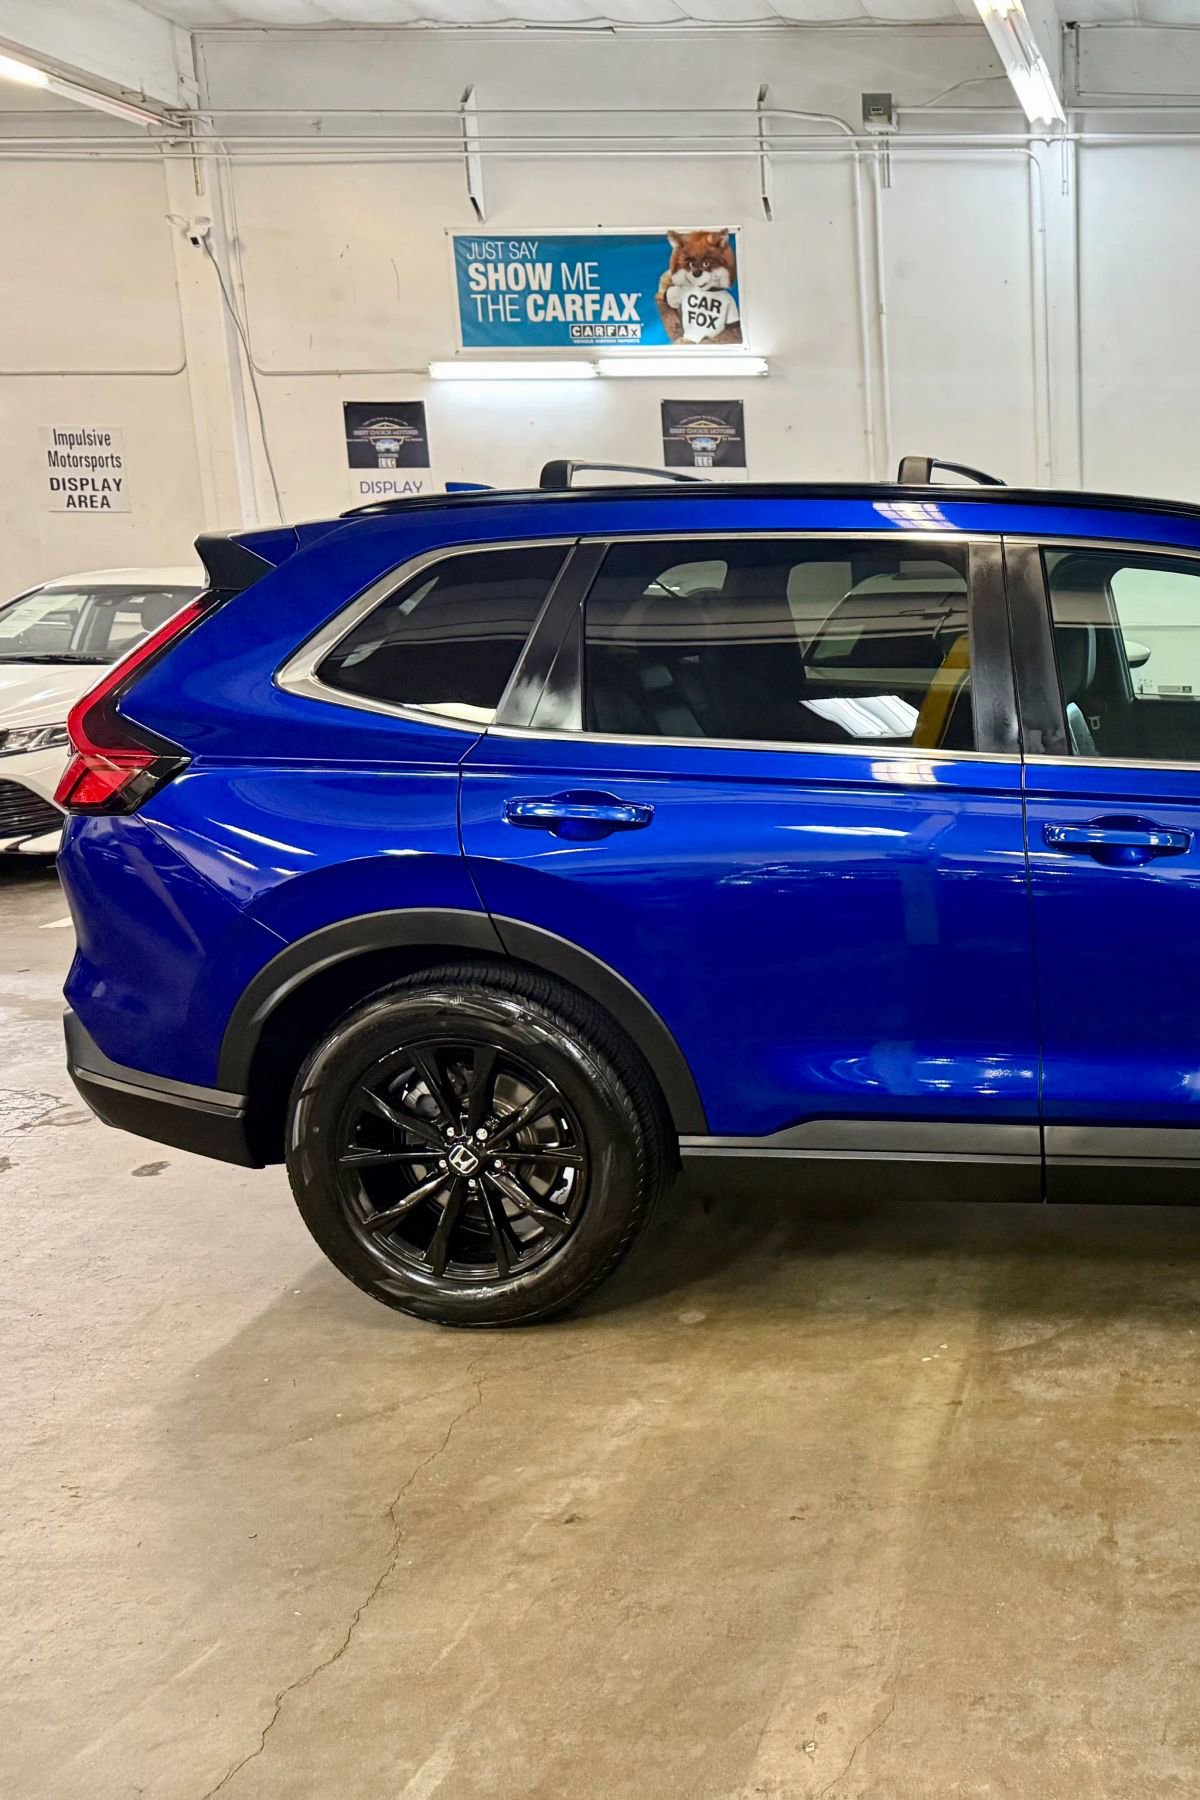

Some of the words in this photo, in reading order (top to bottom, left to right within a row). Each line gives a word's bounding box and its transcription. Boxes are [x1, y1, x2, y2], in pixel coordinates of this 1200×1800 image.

[467, 241, 504, 260] JUST
[509, 241, 538, 260] SAY
[468, 262, 552, 291] SHOW
[560, 261, 600, 291] ME
[470, 293, 521, 322] THE
[526, 292, 641, 323] CARFAX
[687, 294, 722, 315] CAR
[687, 310, 719, 330] FOX
[52, 428, 111, 450] Impulsive
[47, 450, 122, 472] Motorsports
[49, 477, 122, 492] DISPLAY
[360, 480, 423, 494] DISPLAY
[66, 494, 112, 509] AREA
